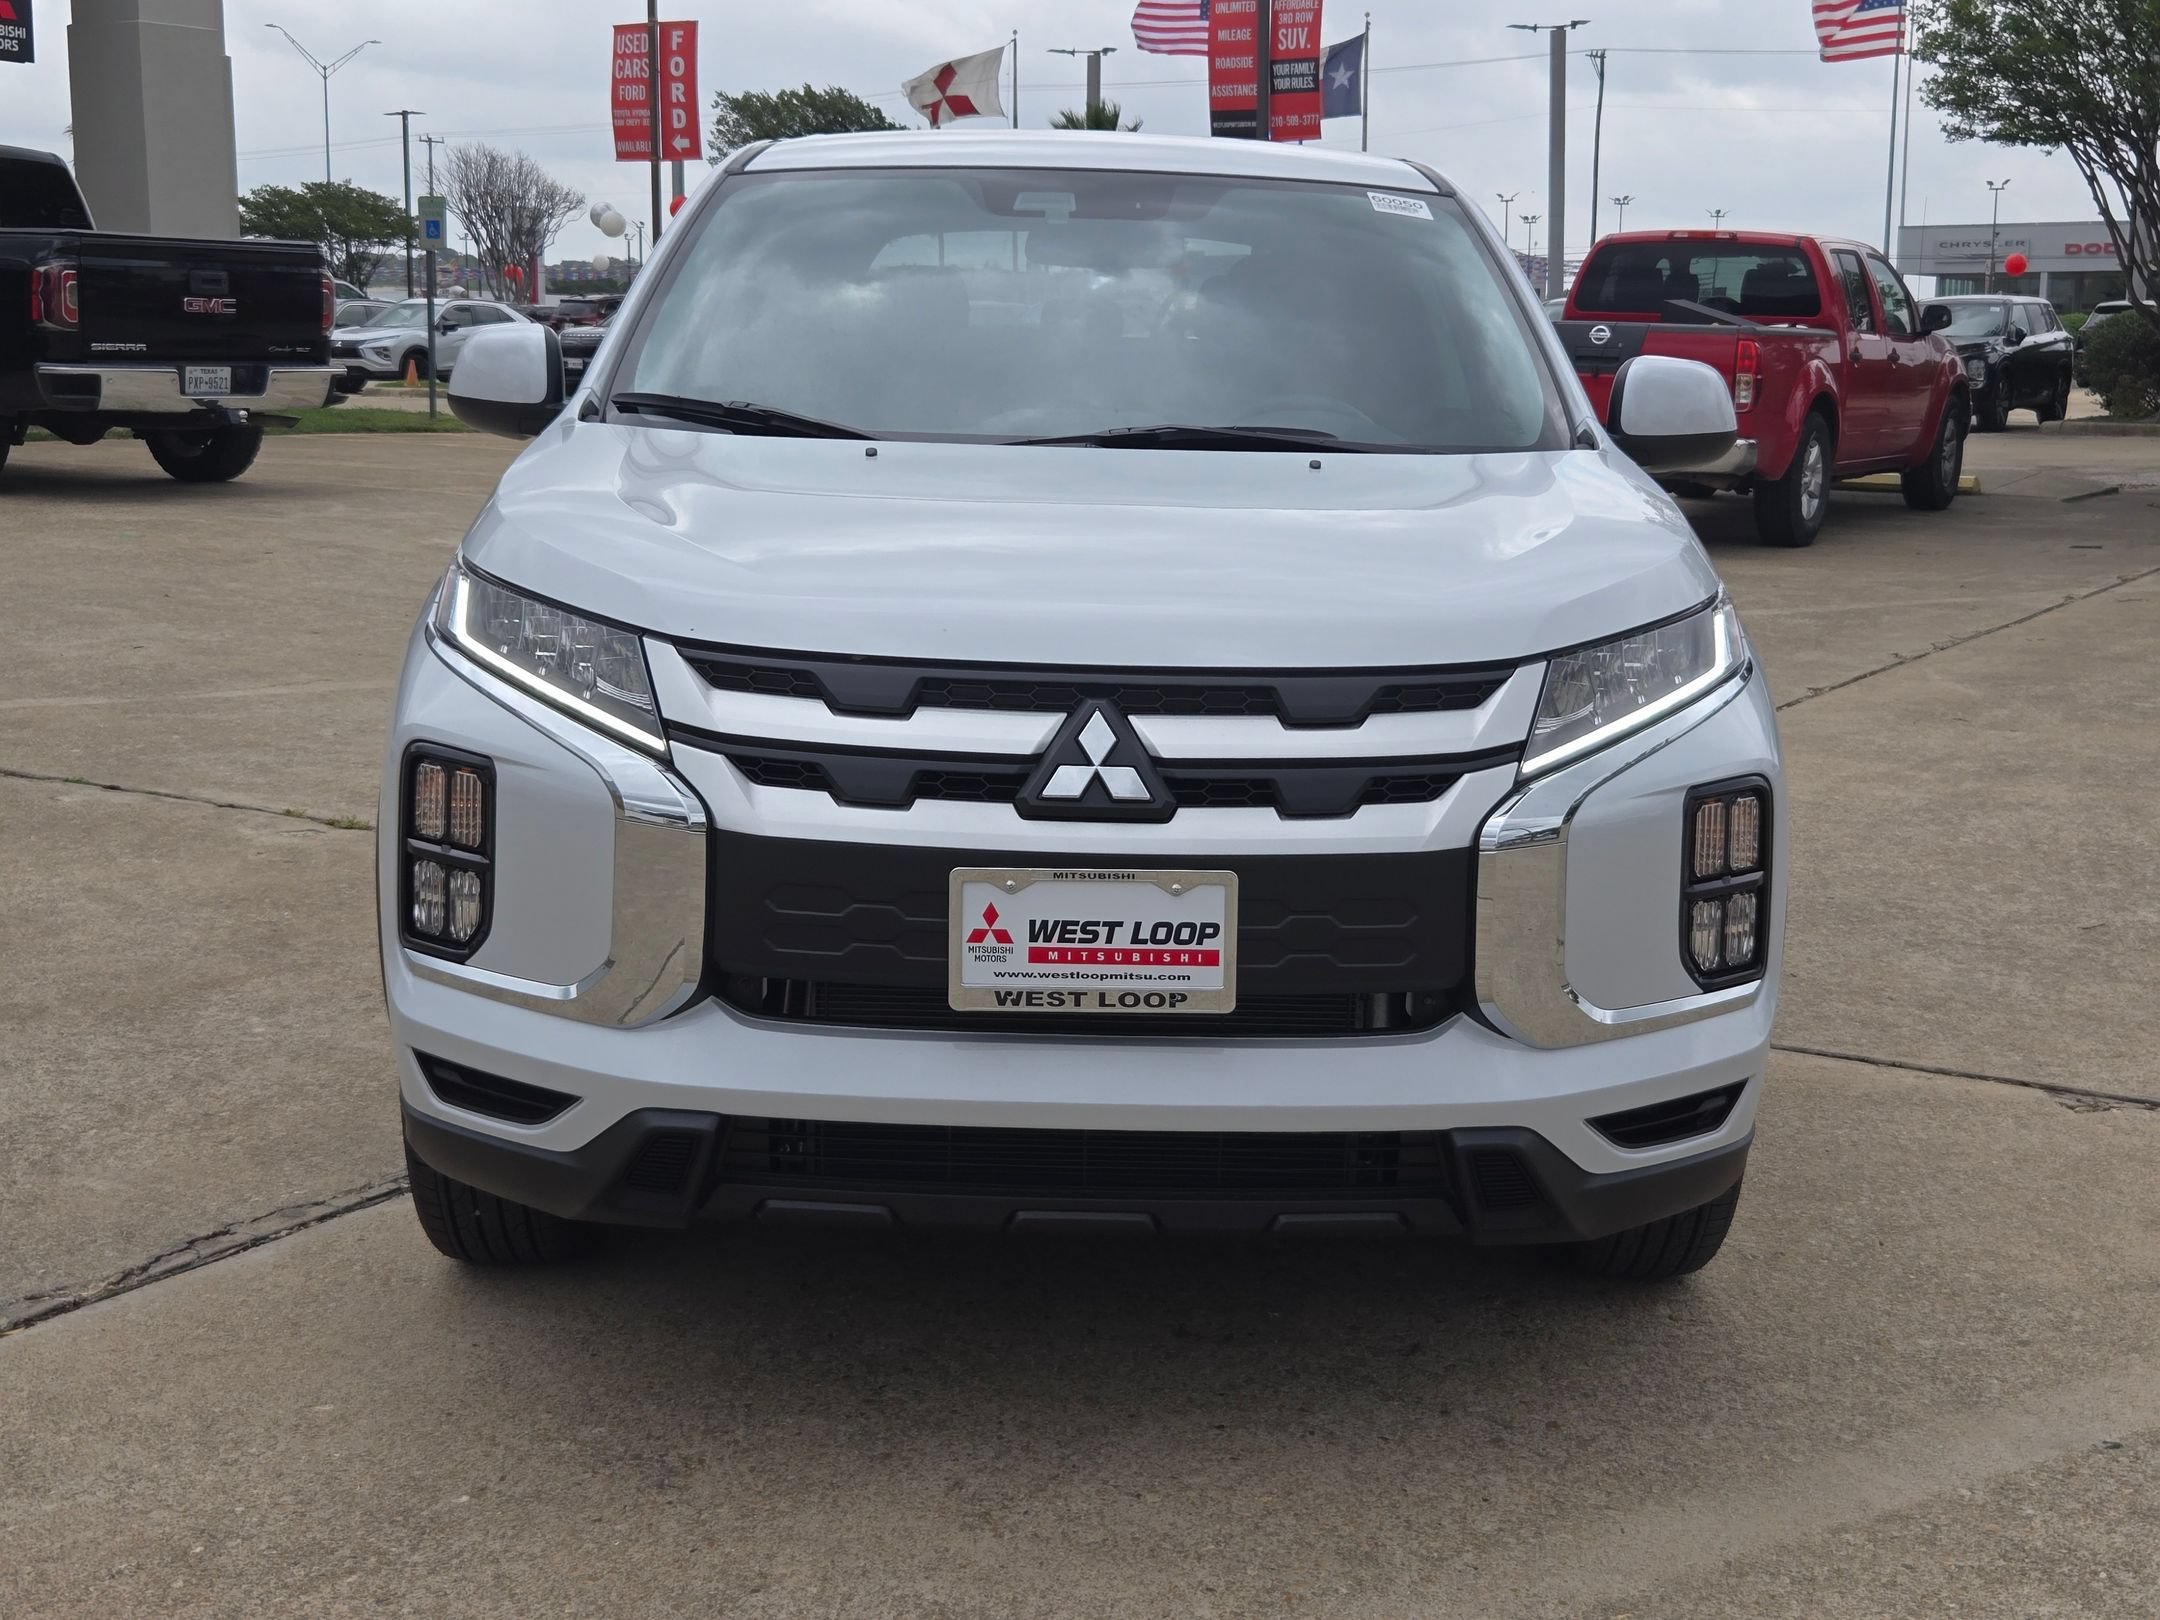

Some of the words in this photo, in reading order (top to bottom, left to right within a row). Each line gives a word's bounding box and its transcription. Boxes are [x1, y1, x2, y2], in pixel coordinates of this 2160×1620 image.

[1215, 1, 1256, 14] UNLIMITED
[1274, 0, 1319, 11] AFFORDABLE
[1278, 13, 1293, 24] 3RD
[1295, 12, 1314, 23] ROW
[1218, 29, 1252, 41] MILEAGE
[1278, 28, 1311, 50] SUV.
[616, 33, 649, 54] USED
[615, 58, 650, 79] CARS
[1215, 56, 1254, 69] ROADSIDE
[1273, 64, 1291, 76] YOUR
[1291, 62, 1316, 75] FAMILY.
[670, 30, 687, 129] FORD
[1274, 78, 1291, 90] YOUR
[1291, 77, 1315, 89] RULES.
[619, 85, 646, 101] FORD
[1212, 84, 1258, 97] ASSISTANCE
[2064, 242, 2116, 255] DOD
[184, 297, 237, 314] GMC
[91, 343, 147, 351] SIERRA
[1052, 872, 1136, 880] MITSUBISHI
[1028, 919, 1124, 945] WEST
[1129, 921, 1221, 946] LOOP
[968, 946, 1014, 955] MITSUBISHI
[1048, 951, 1202, 963] MITSUBISHI
[974, 955, 1007, 963] MOTORS
[993, 971, 1191, 981] www.westloopmitsu.com
[994, 990, 1088, 1008] WEST
[1098, 992, 1188, 1009] LOOP
